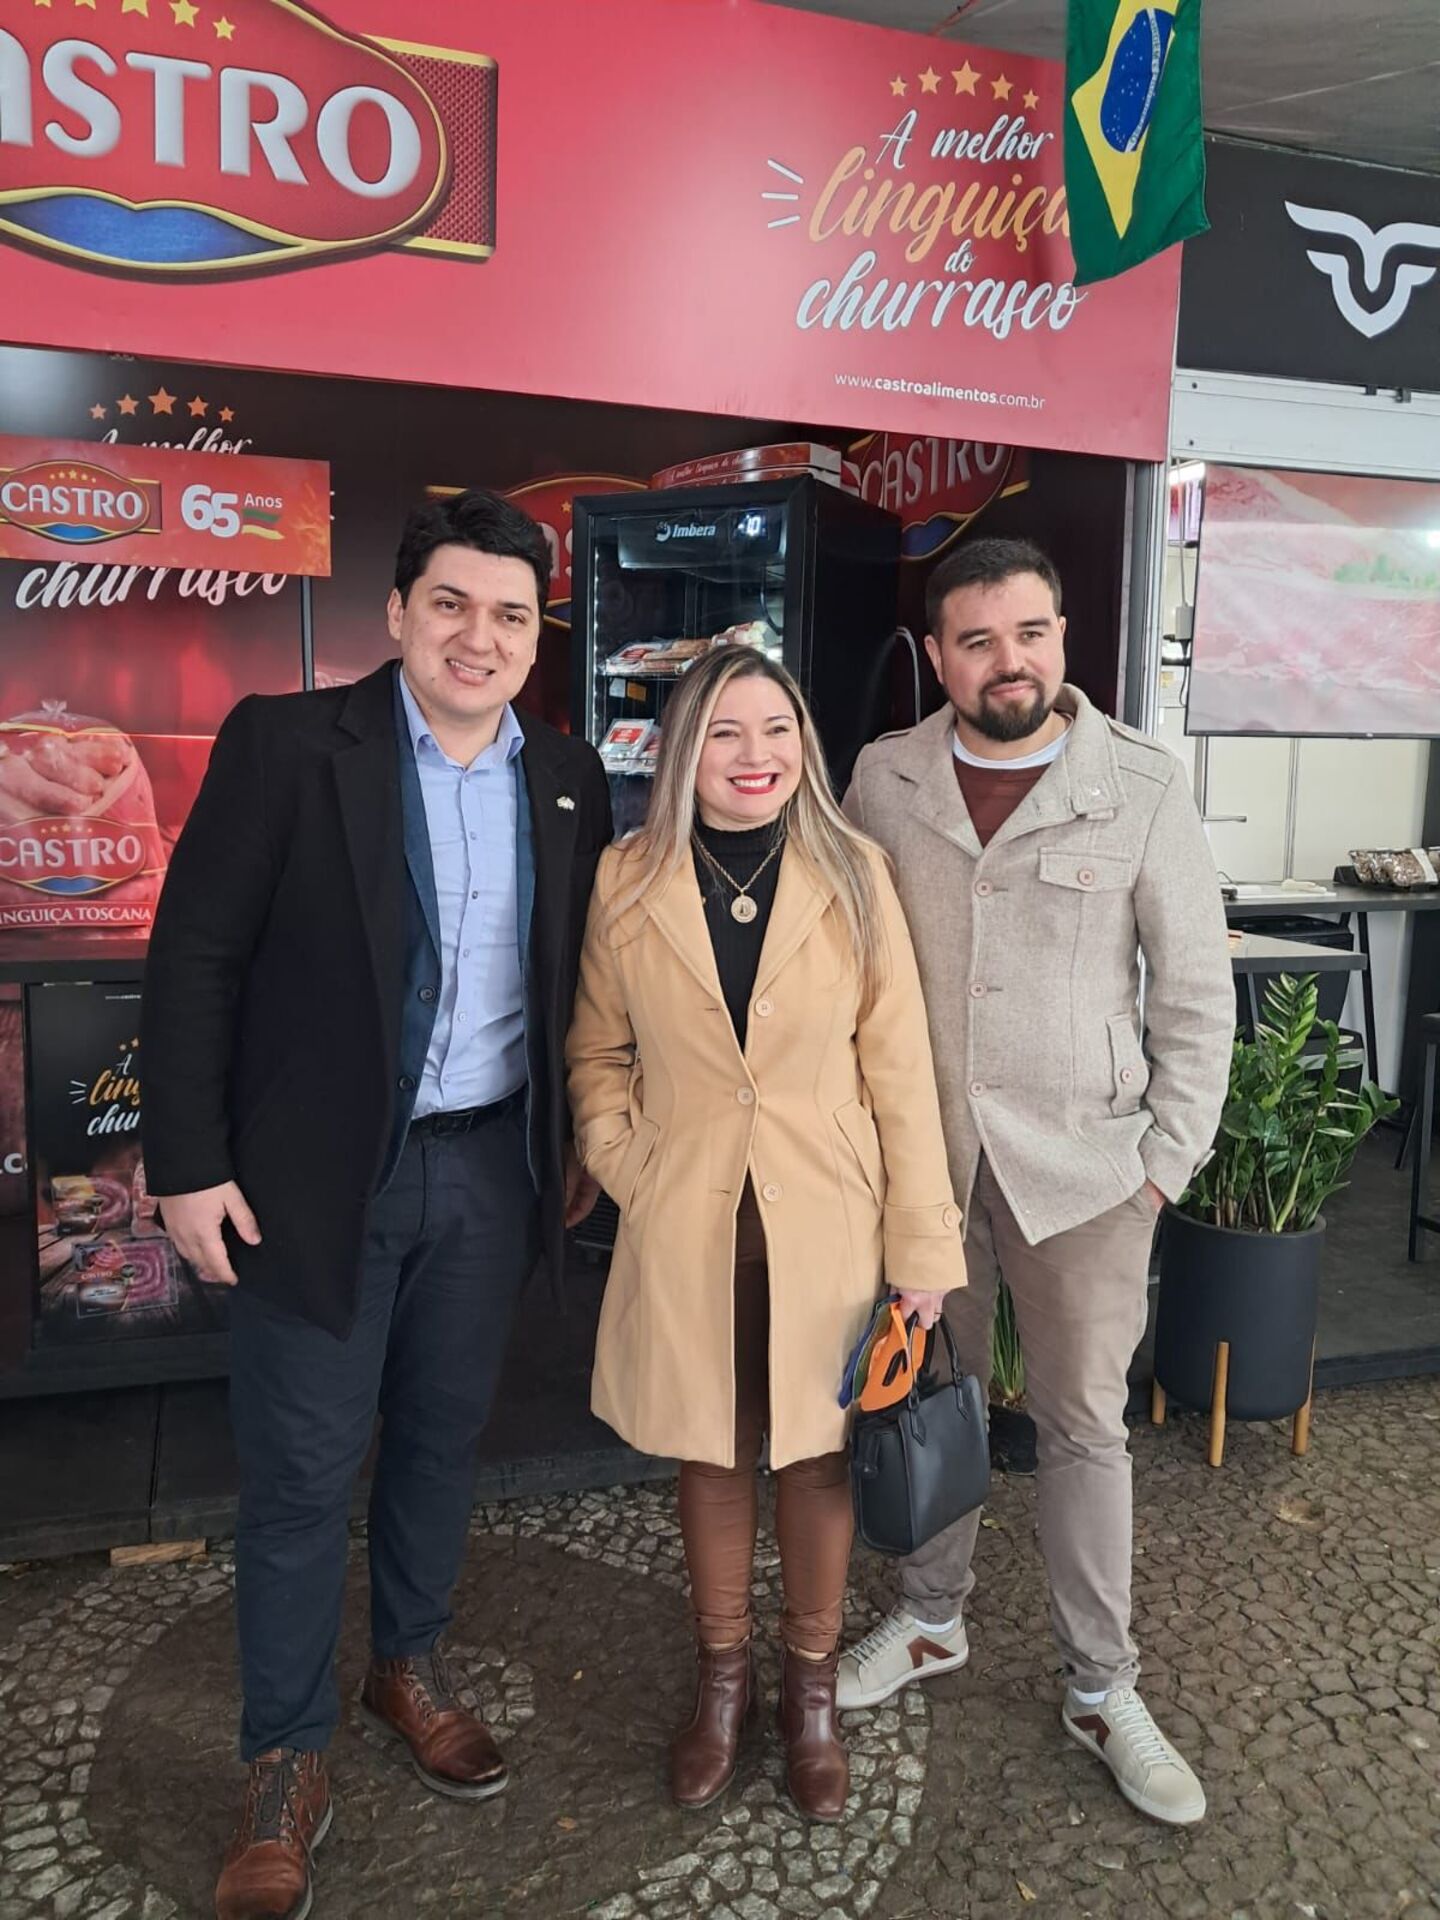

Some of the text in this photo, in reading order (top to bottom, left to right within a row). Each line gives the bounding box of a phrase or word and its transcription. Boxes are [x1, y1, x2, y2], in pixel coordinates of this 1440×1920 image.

[875, 109, 1054, 169] A melhor
[944, 239, 977, 273] do
[796, 250, 1089, 339] churrasco
[834, 372, 1046, 409] www.castroalimentos.com.br
[1, 482, 241, 538] CASTRO 65
[244, 493, 283, 509] Anos
[672, 523, 717, 538] Imbera
[76, 907, 152, 921] TOSCANA
